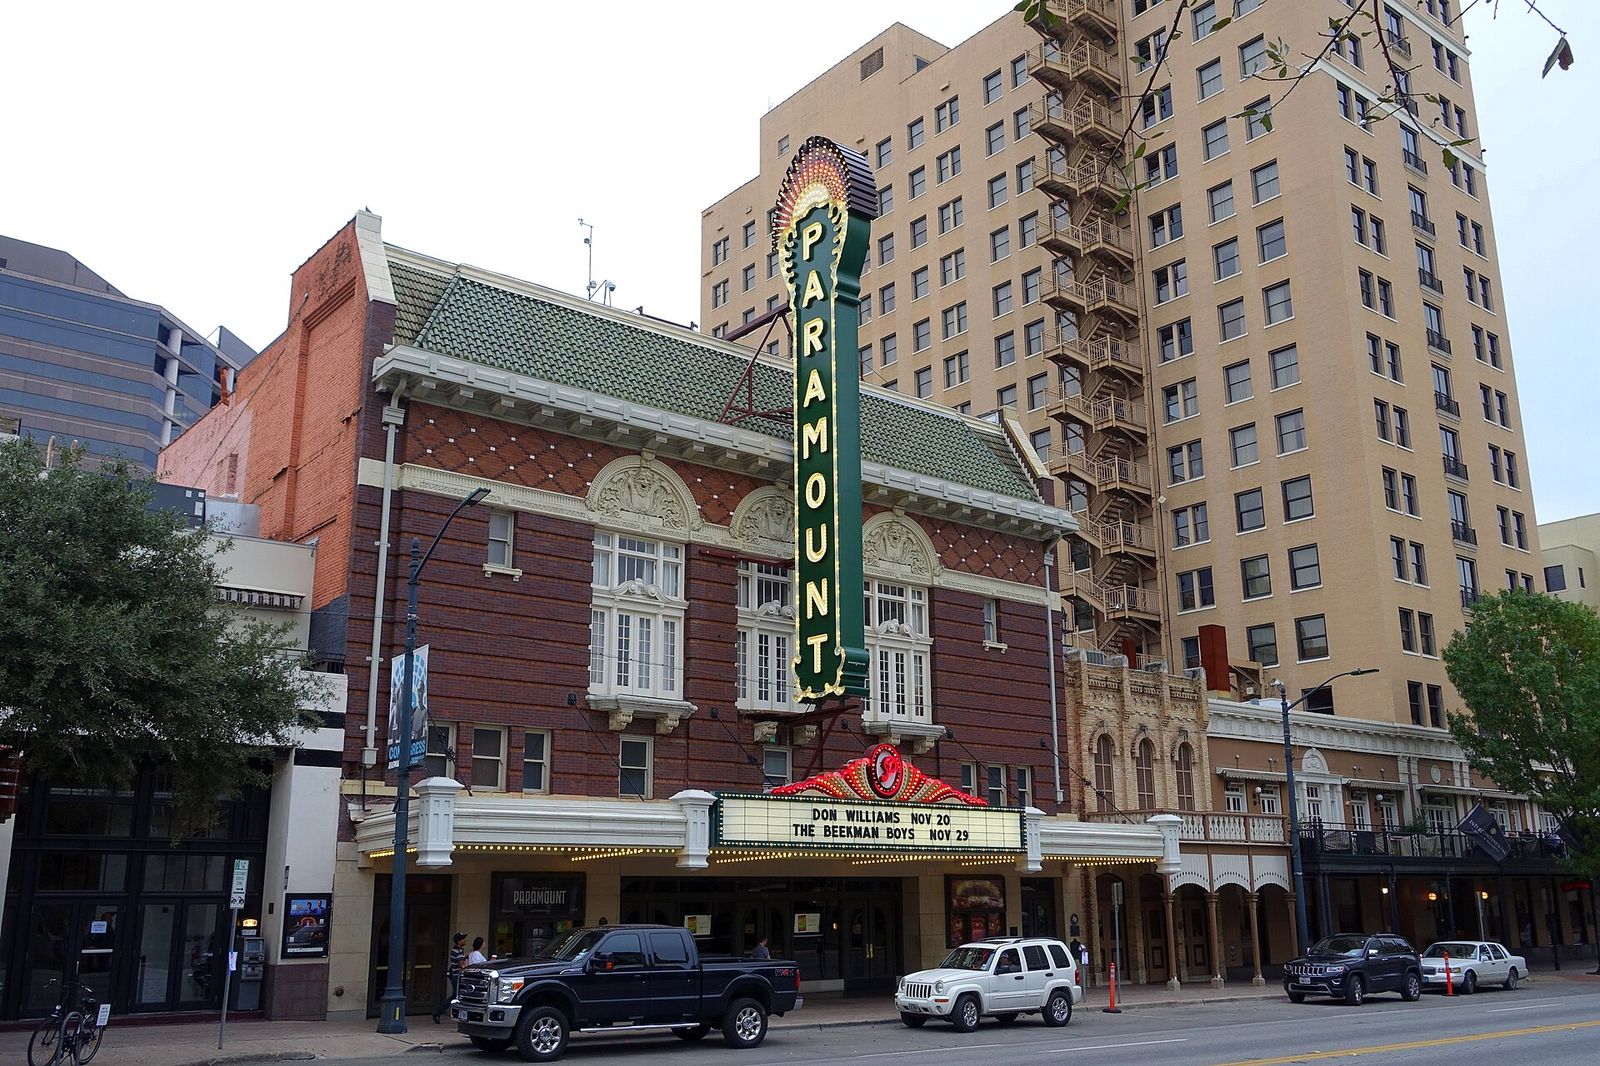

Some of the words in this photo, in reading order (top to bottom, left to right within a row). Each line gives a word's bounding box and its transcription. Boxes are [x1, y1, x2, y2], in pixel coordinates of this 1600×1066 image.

[802, 221, 828, 674] PARAMOUNT
[388, 739, 426, 760] CORESS
[812, 808, 837, 821] DON
[846, 809, 900, 824] WILLIAMS
[911, 812, 932, 825] NOV
[936, 814, 950, 826] 20
[792, 823, 815, 837] THE
[823, 825, 879, 839] BEEKMAN
[886, 827, 915, 840] BOYS
[929, 828, 951, 841] NOV
[956, 829, 969, 841] 29
[513, 890, 568, 905] PARAMOUNT
